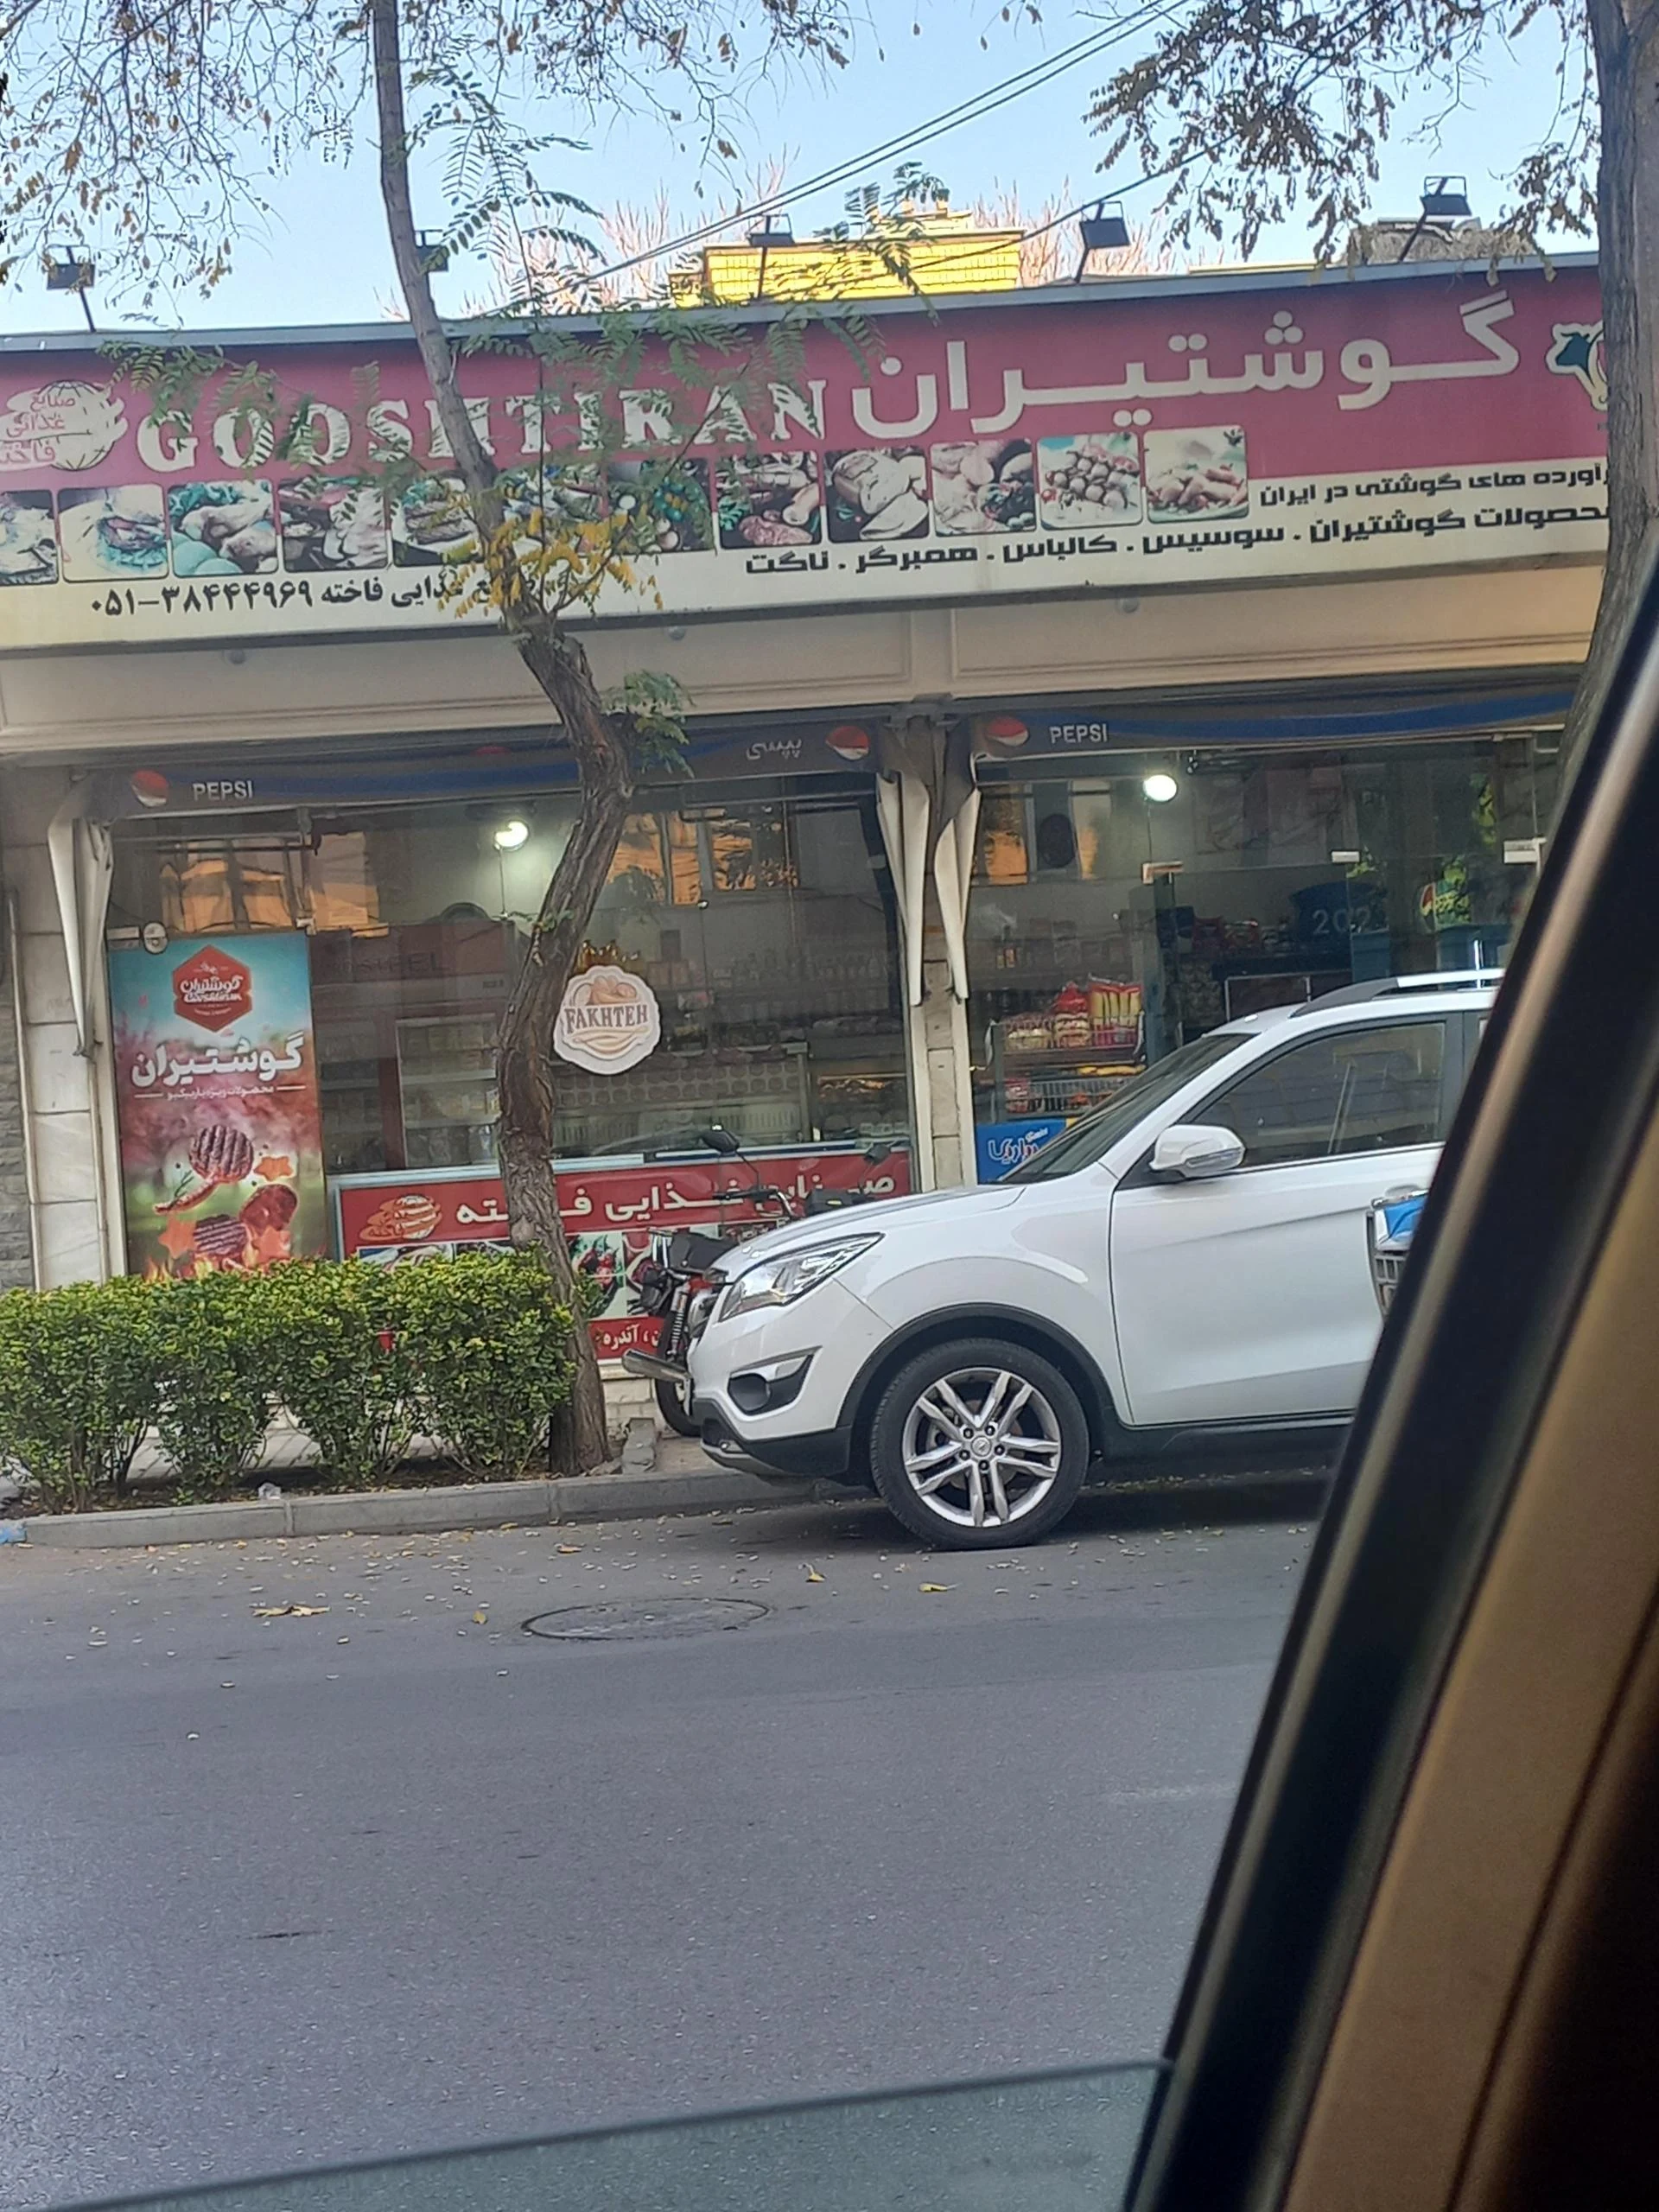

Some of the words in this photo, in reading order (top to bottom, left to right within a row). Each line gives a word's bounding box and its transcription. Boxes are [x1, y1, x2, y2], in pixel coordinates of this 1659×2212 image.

[851, 289, 1521, 440] گوشتیران
[0, 440, 56, 464] فاخت
[1355, 473, 1461, 497] گوشتی
[1470, 472, 1526, 489] های
[1260, 483, 1316, 507] ایران
[1324, 485, 1348, 504] در
[1309, 509, 1465, 543] گوشتیران
[1474, 505, 1610, 531] حصولات
[1002, 534, 1117, 563] کالباس
[1142, 526, 1283, 555] سوسیس
[855, 545, 978, 575] همبرگر
[321, 576, 384, 603] فاخته
[1050, 723, 1109, 745] PEPSI
[746, 739, 803, 760] پپسی
[193, 779, 254, 802] PEPSI
[564, 1004, 648, 1034] FAKHTEH
[131, 1032, 305, 1088] گوشتیران
[456, 1188, 593, 1224] فته
